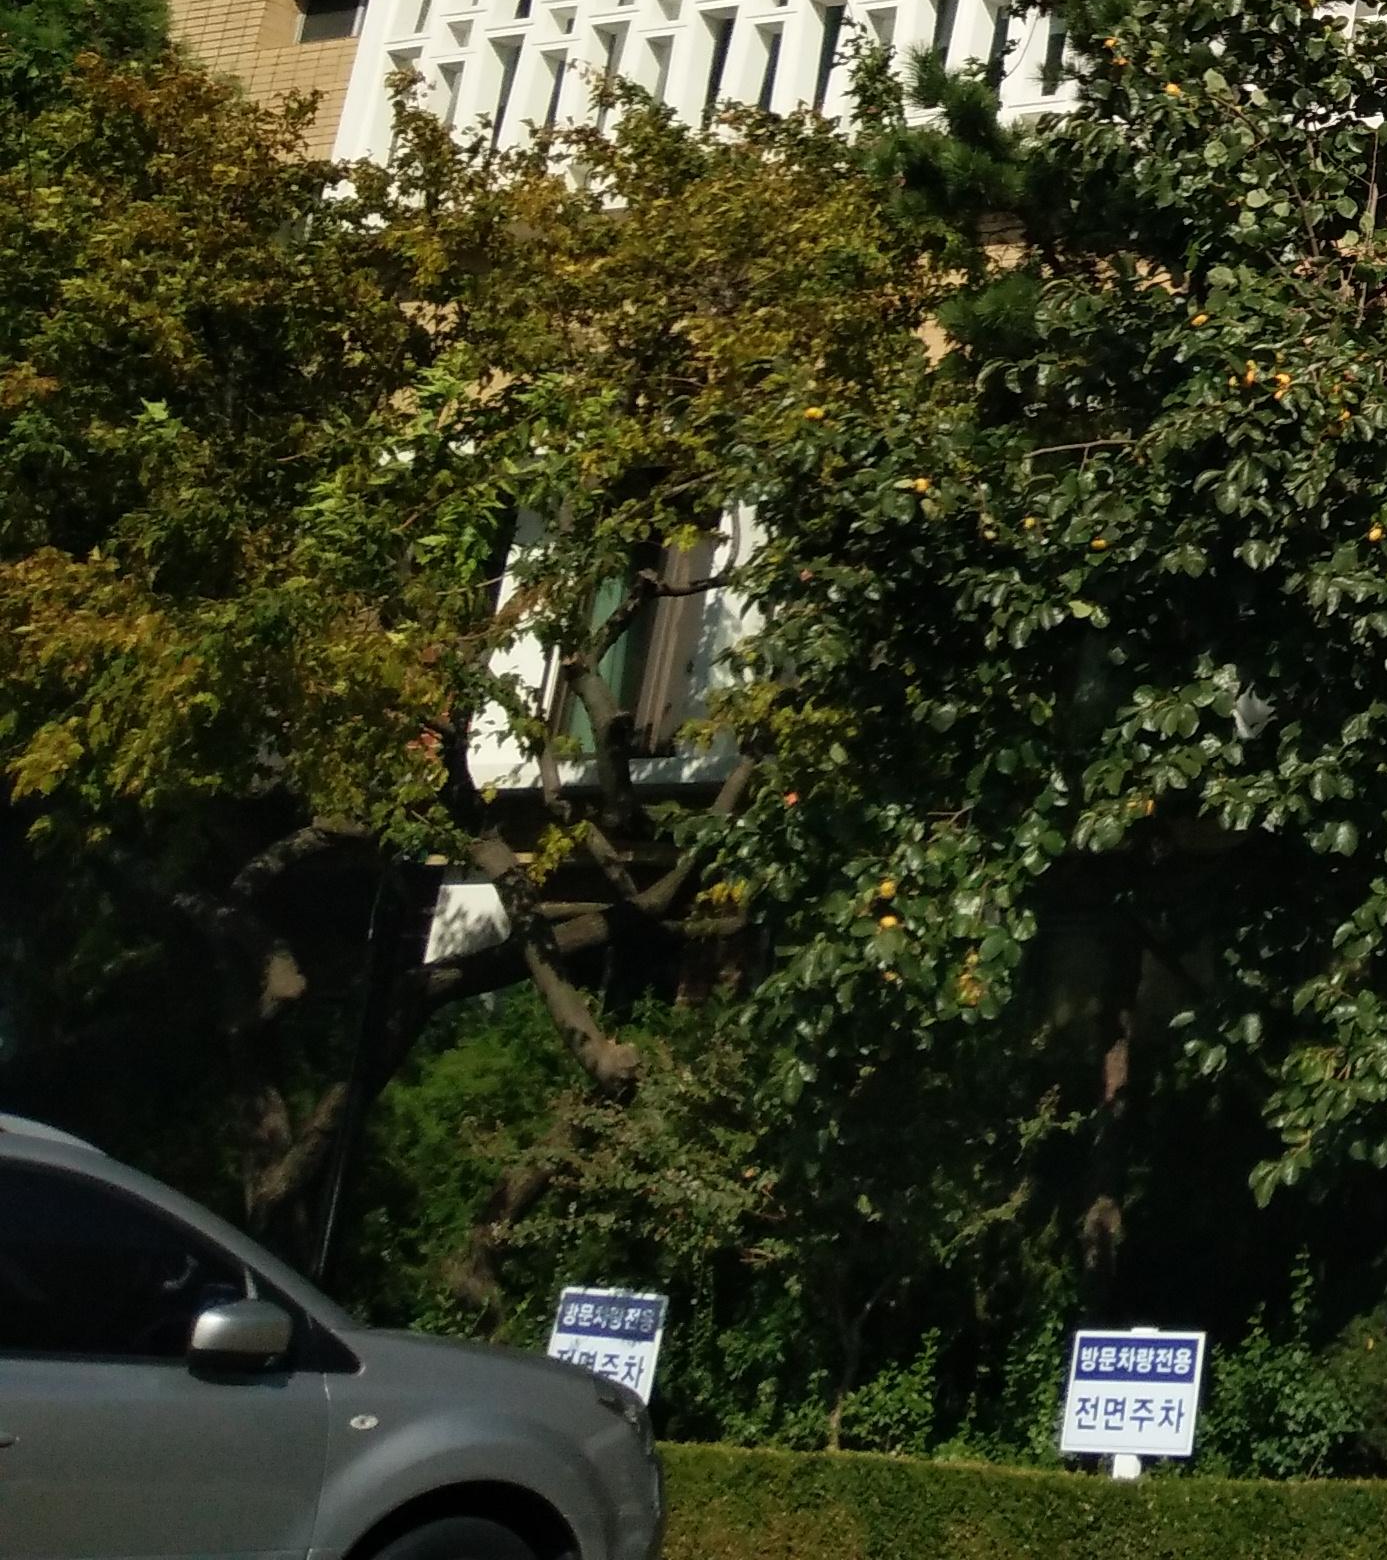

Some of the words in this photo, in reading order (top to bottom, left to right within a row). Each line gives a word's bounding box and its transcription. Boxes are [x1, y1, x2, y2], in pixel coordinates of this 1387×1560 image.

[562, 1303, 656, 1333] 방문차량전용
[1080, 1346, 1193, 1375] 방문차량전용
[1075, 1396, 1185, 1434] 전면주차
